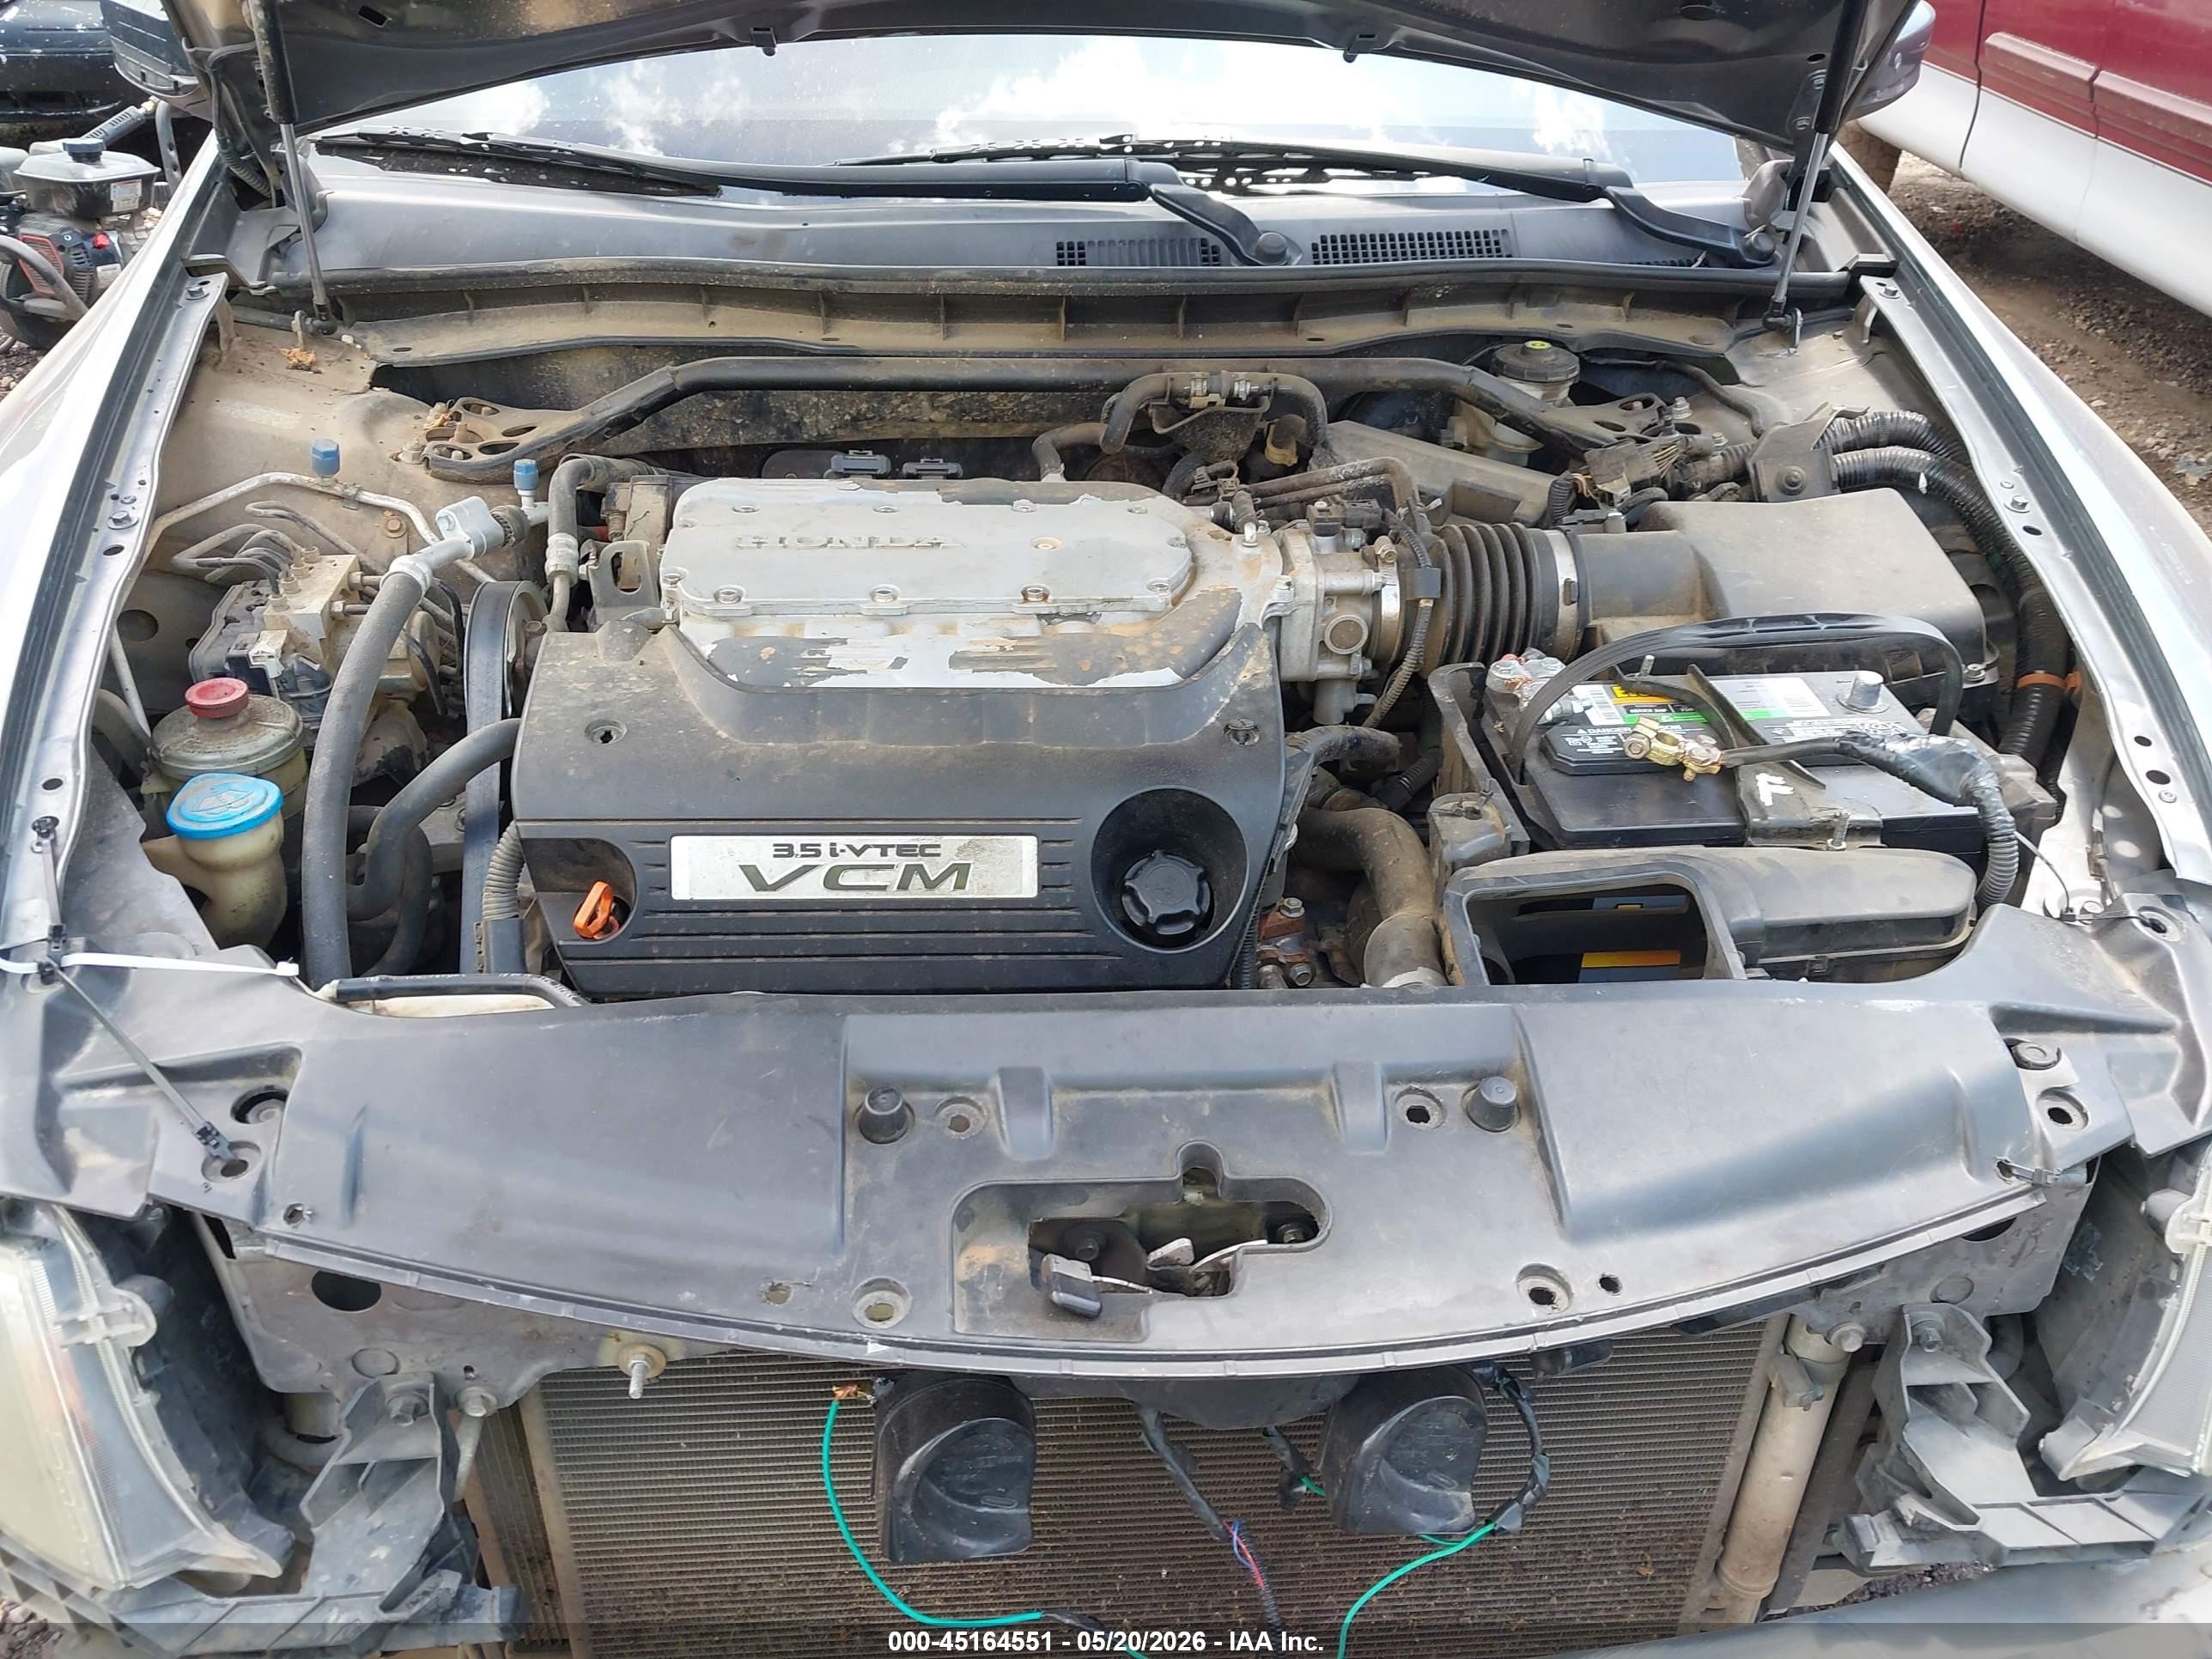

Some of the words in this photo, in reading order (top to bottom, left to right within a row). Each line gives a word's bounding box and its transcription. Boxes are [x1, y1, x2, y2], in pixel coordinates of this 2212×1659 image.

[736, 535, 967, 550] HONDA
[829, 842, 942, 858] i-VTEC
[738, 863, 973, 892] VCM
